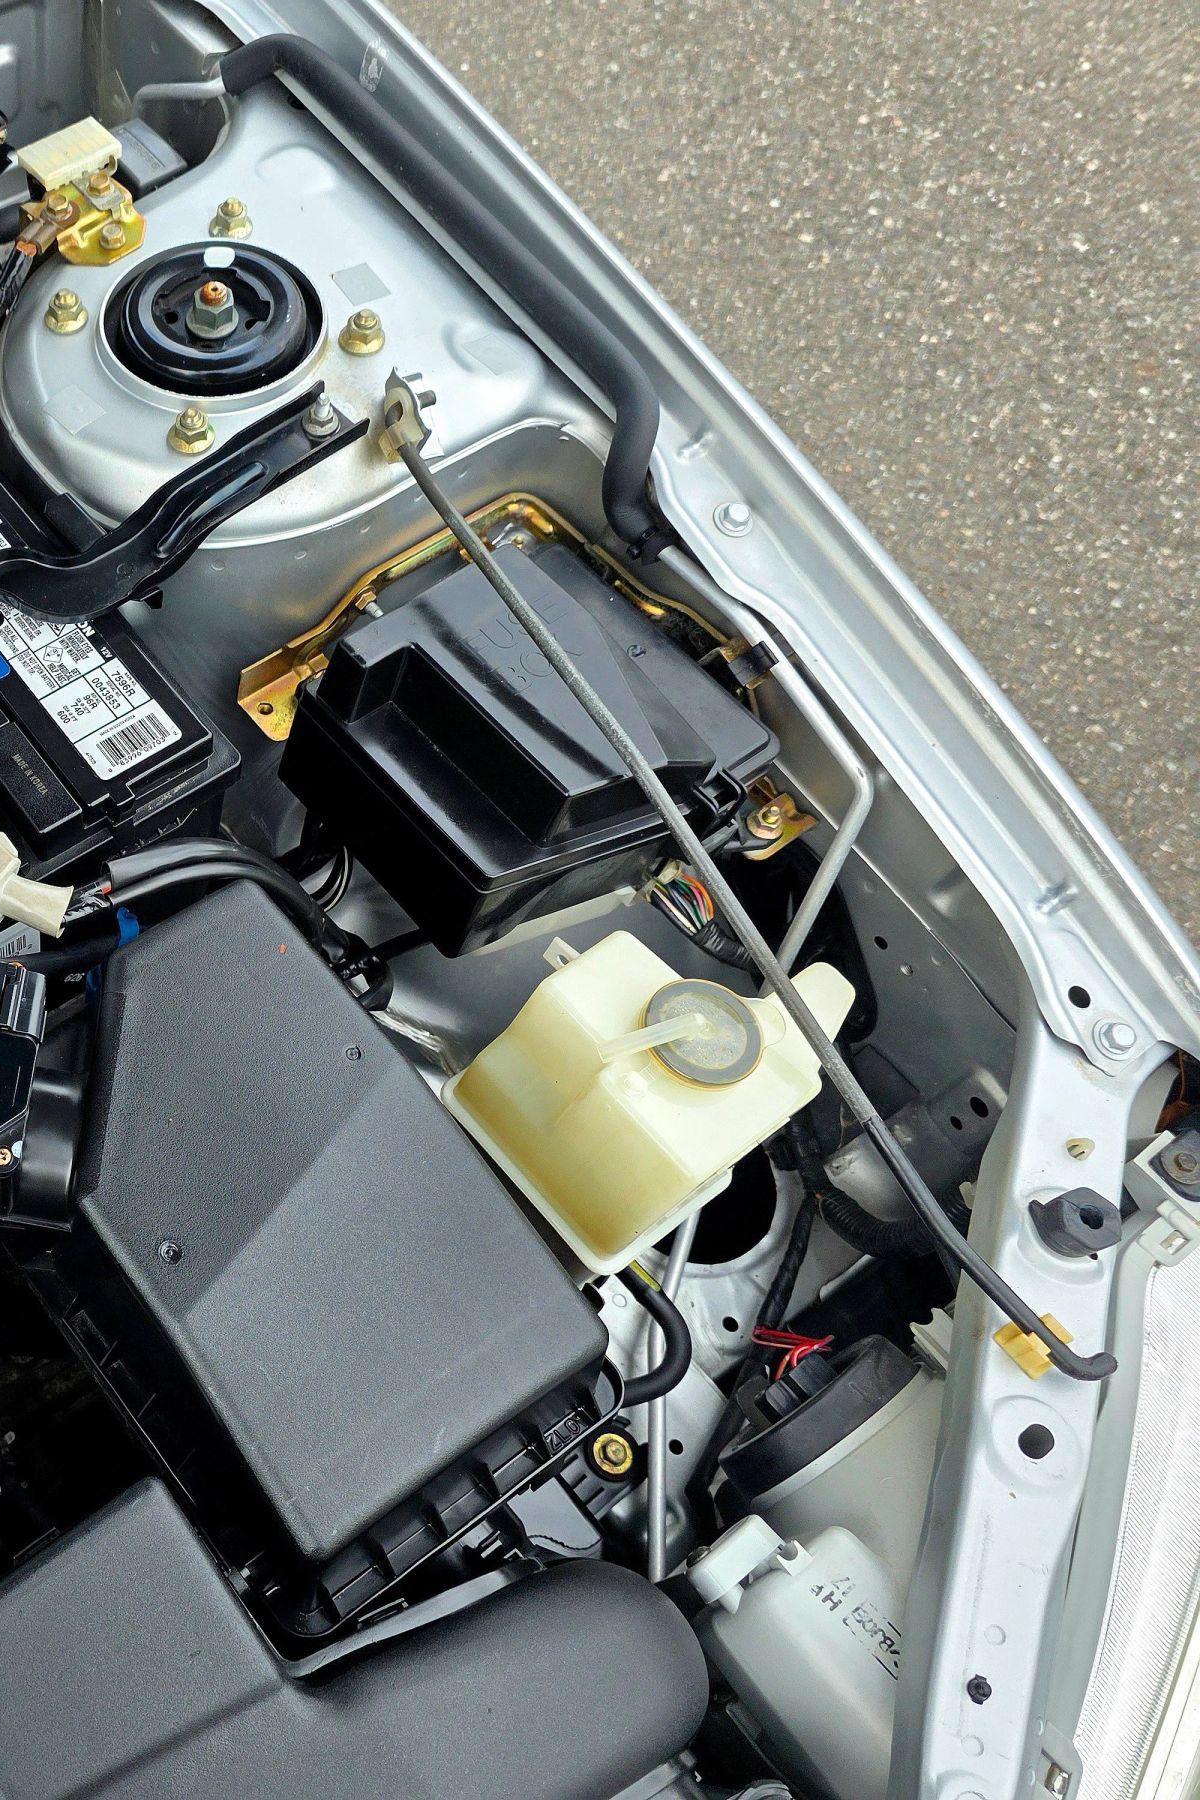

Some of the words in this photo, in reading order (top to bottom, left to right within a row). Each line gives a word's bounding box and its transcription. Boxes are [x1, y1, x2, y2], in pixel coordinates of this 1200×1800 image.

[99, 645, 112, 660] 12V
[91, 676, 121, 710] 0043853
[111, 670, 135, 696] 7596R
[70, 702, 84, 716] 740
[83, 694, 98, 710] 96R
[57, 710, 70, 724] 600
[118, 749, 142, 766] 83996
[142, 736, 166, 752] 09703
[11, 752, 28, 770] MADE
[29, 774, 48, 795] KOREA
